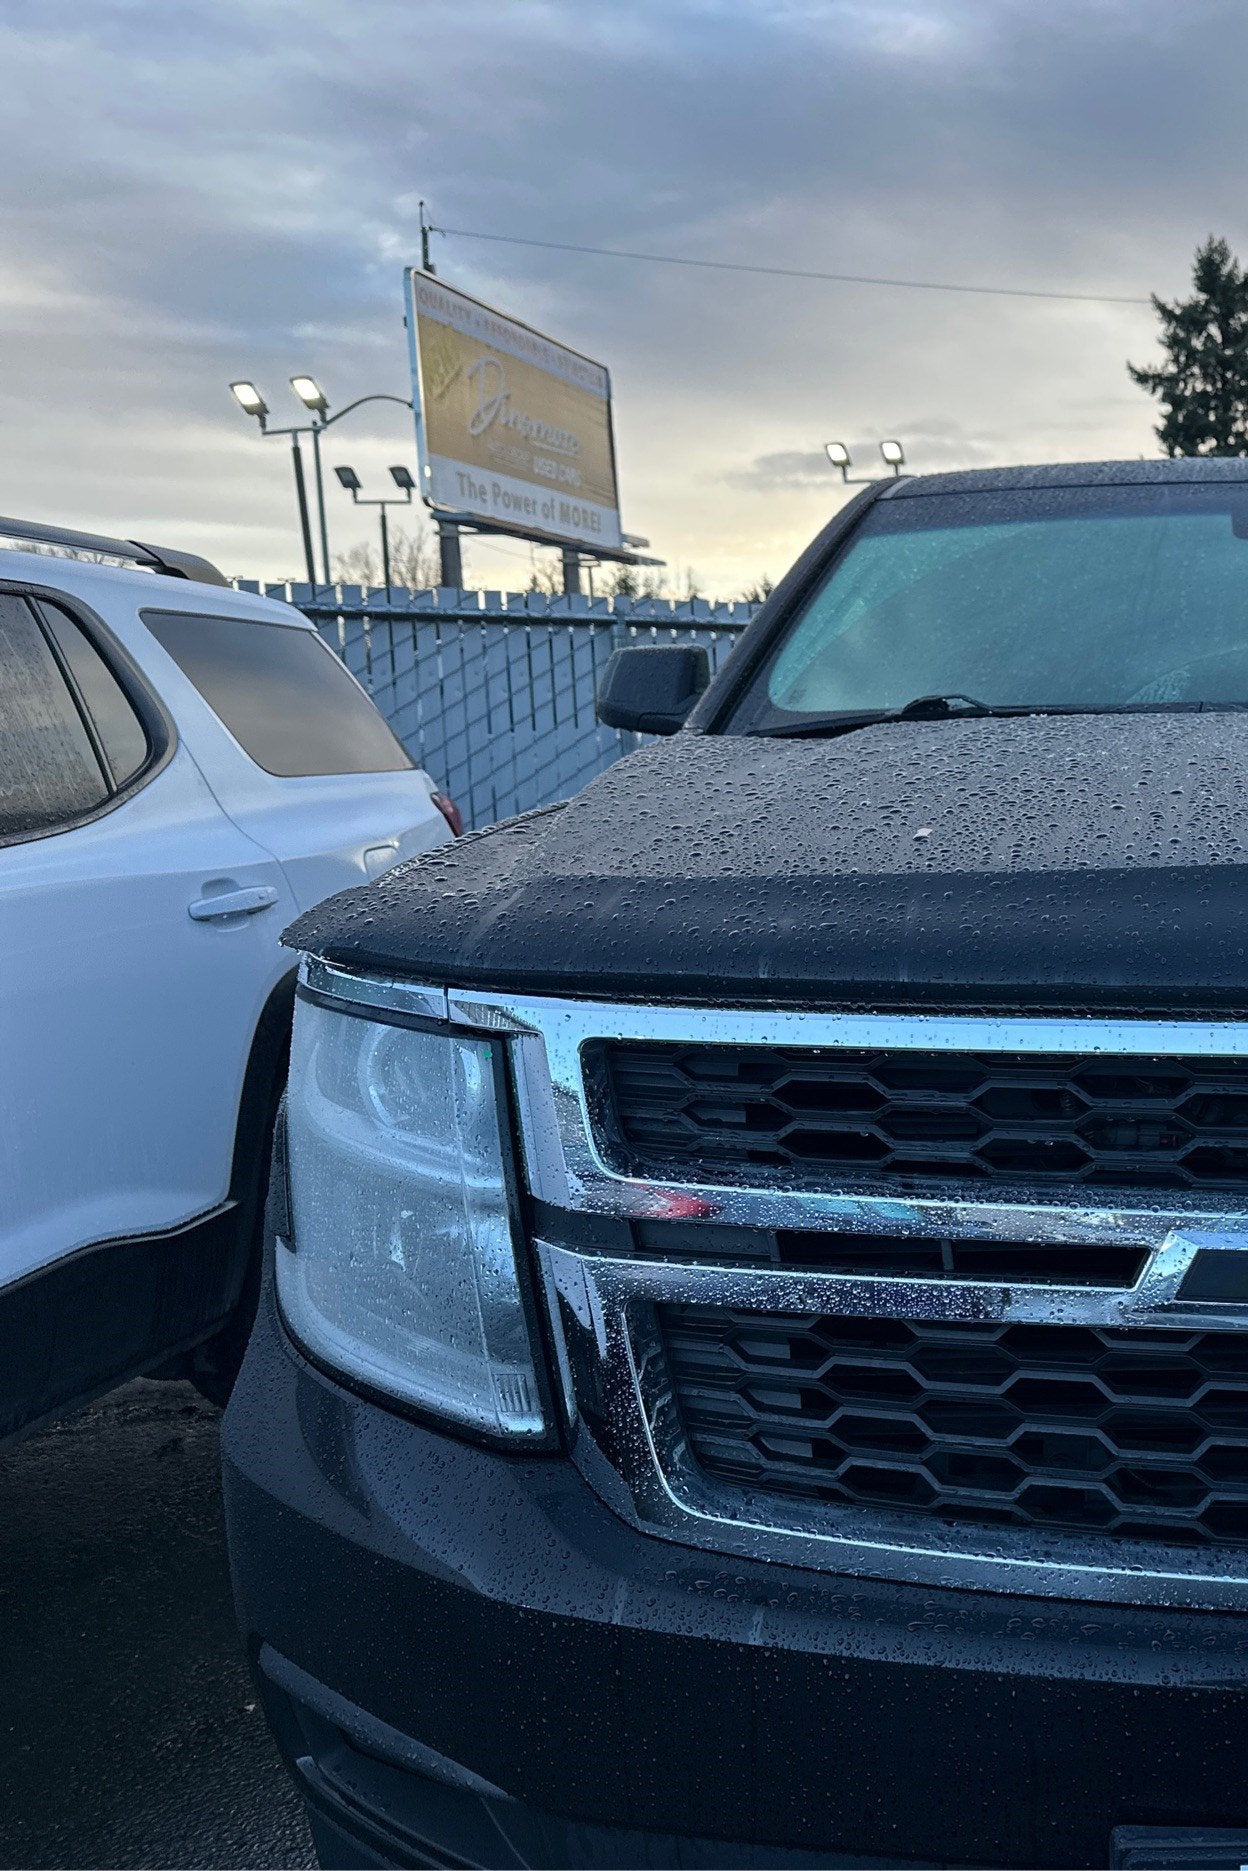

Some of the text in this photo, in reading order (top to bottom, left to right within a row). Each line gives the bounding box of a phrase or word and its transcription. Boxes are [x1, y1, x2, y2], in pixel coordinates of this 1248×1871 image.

[455, 471, 602, 533] The Power of MORE!
